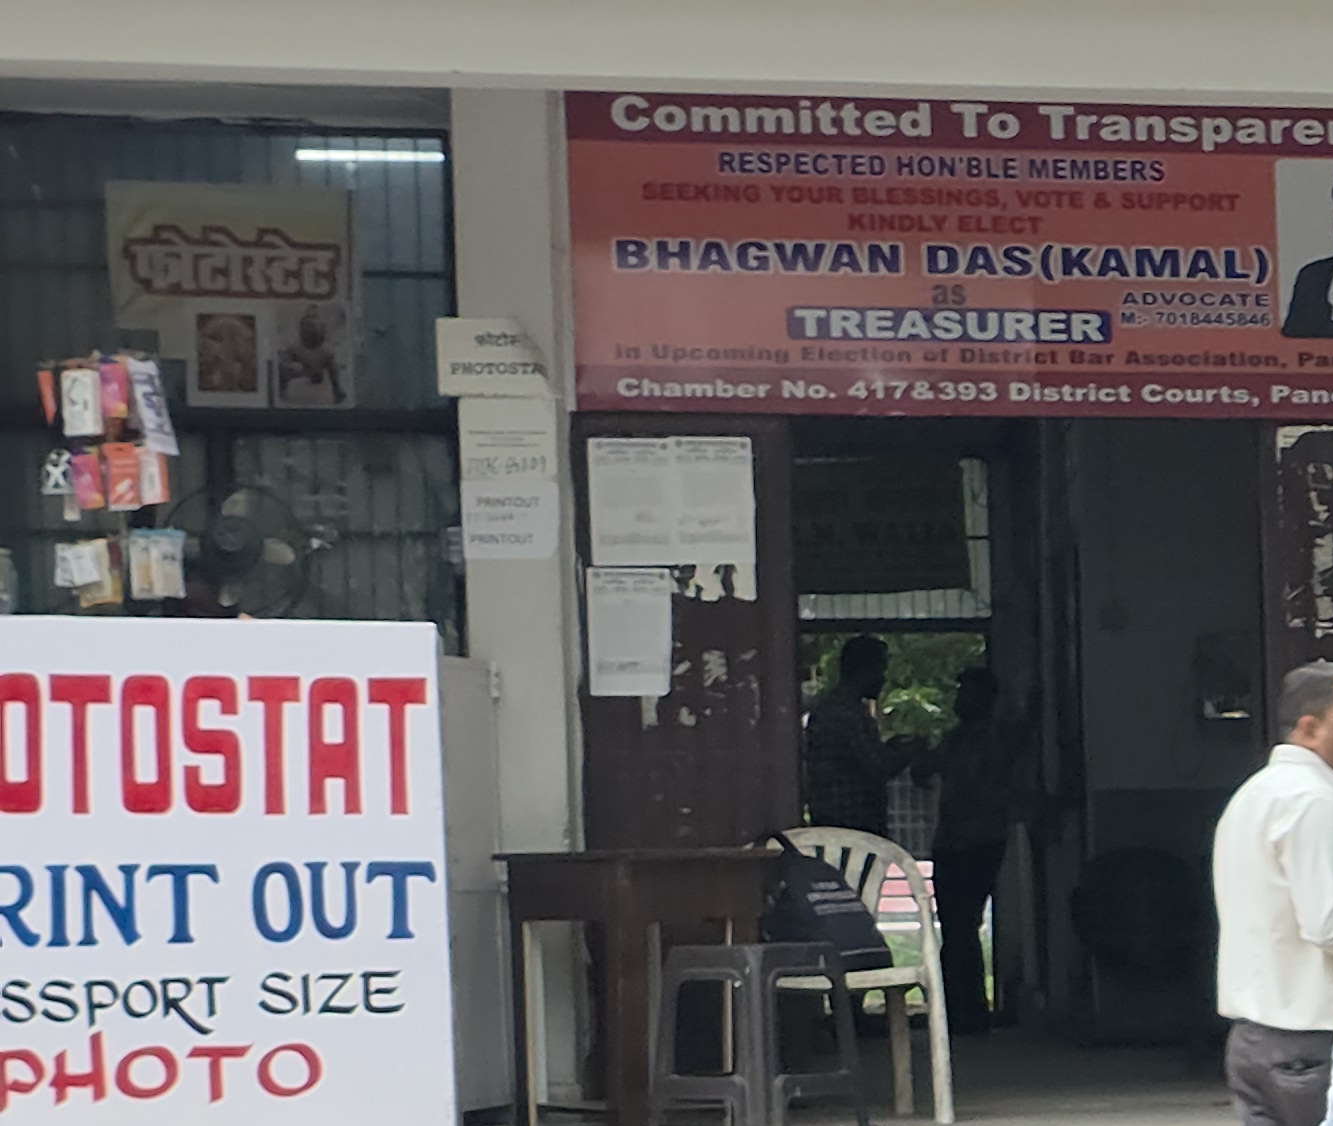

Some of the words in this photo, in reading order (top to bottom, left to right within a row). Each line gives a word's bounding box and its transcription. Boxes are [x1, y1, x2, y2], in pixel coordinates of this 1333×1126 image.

[611, 95, 932, 136] Committed
[951, 103, 1020, 139] To
[718, 152, 886, 176] RESPECTED
[897, 155, 1018, 178] HON'BLE
[1029, 159, 1165, 182] MEMBERS
[642, 182, 762, 202] SEEKING
[772, 184, 843, 205] YOUR
[852, 186, 1009, 209] BLESSINGS,
[1016, 190, 1083, 209] VOTE
[1093, 192, 1115, 209] &
[1121, 192, 1240, 211] SUPPORT
[848, 213, 948, 232] KINDLY
[958, 215, 1042, 234] ELECT
[614, 239, 901, 274] BHAGWAN
[932, 284, 966, 306] as
[1123, 292, 1270, 307] ADVOCATE
[794, 308, 1104, 342] TREASURER
[1156, 311, 1271, 327] 7018445846
[652, 344, 789, 366] Upcoming
[802, 345, 910, 364] Election
[923, 347, 948, 364] of
[960, 348, 1059, 367] District
[1069, 349, 1114, 366] Bar
[1125, 350, 1287, 370] Association,
[617, 377, 770, 399] Chamber
[782, 380, 836, 399] No.
[1008, 383, 1130, 404] District
[1141, 384, 1260, 407] Courts,
[251, 861, 436, 943] OUT
[259, 969, 404, 1016] SIZE
[0, 1031, 322, 1114] PHOTO
